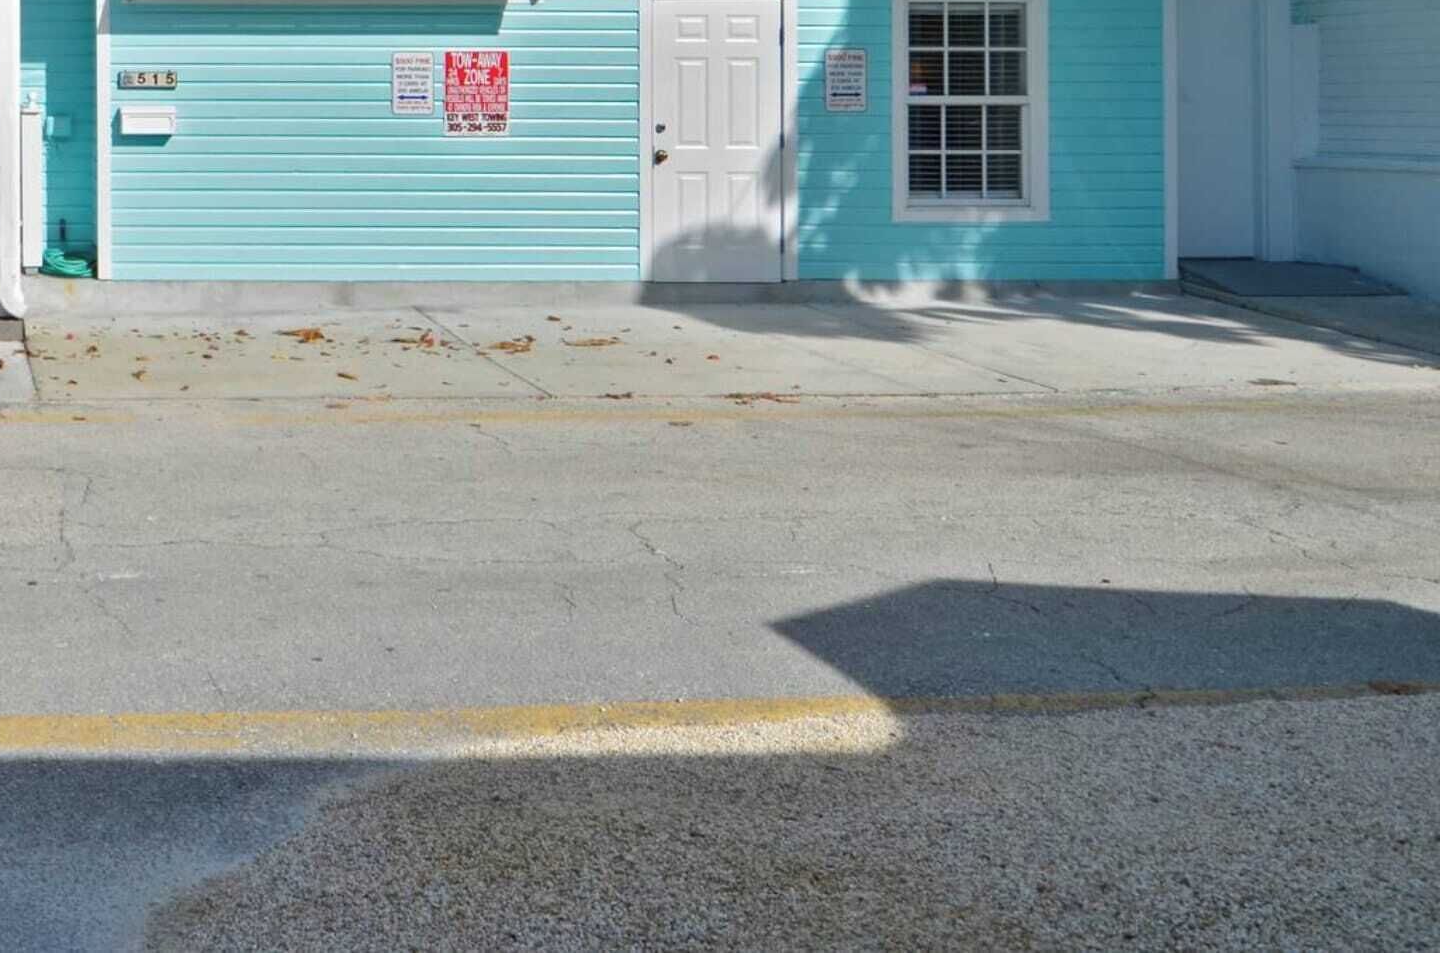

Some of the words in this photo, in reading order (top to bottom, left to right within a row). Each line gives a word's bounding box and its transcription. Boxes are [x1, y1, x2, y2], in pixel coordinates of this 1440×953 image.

[450, 52, 503, 69] TOW-AWAY
[137, 72, 174, 85] 515
[463, 68, 491, 85] ZONE
[461, 113, 479, 121] WEST
[481, 113, 507, 121] TOWING
